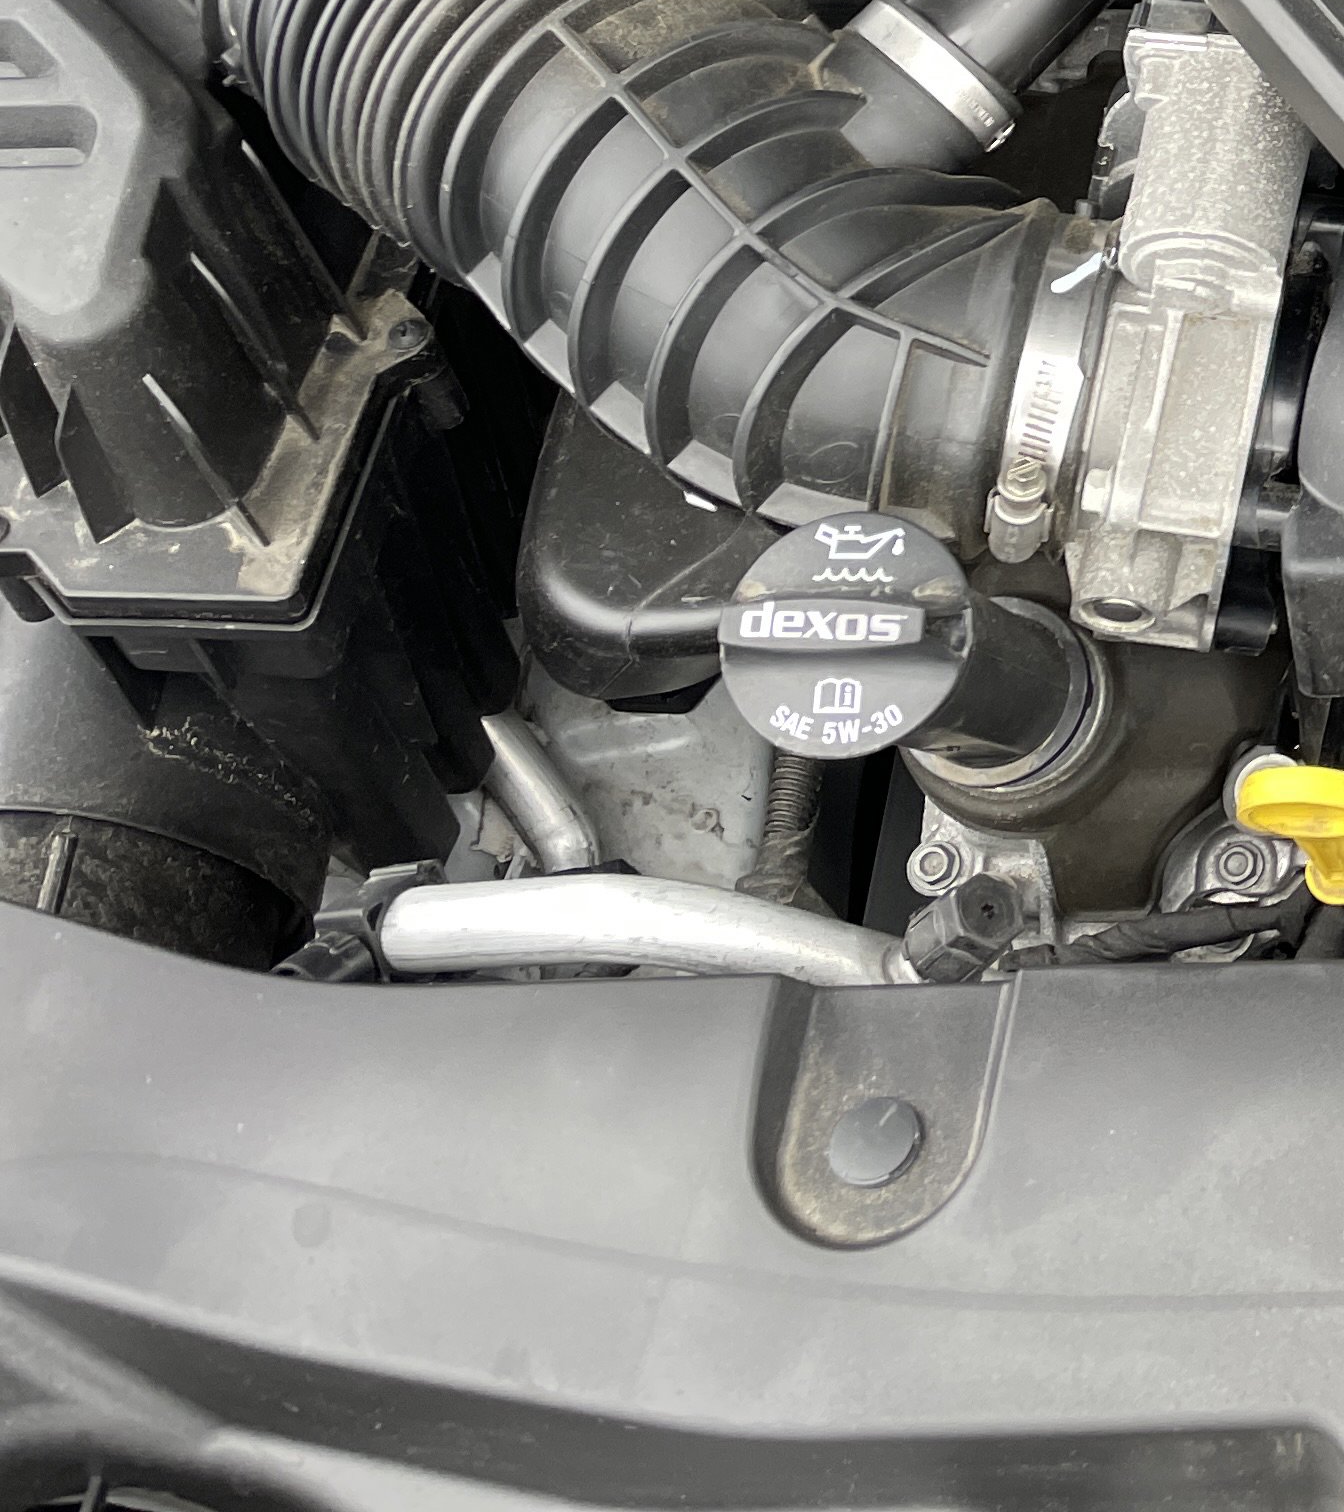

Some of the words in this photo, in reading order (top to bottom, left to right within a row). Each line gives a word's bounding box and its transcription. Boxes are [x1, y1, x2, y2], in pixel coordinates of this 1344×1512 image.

[740, 601, 908, 642] dexos
[769, 704, 815, 740] SAE
[821, 703, 903, 745] 5W-30
